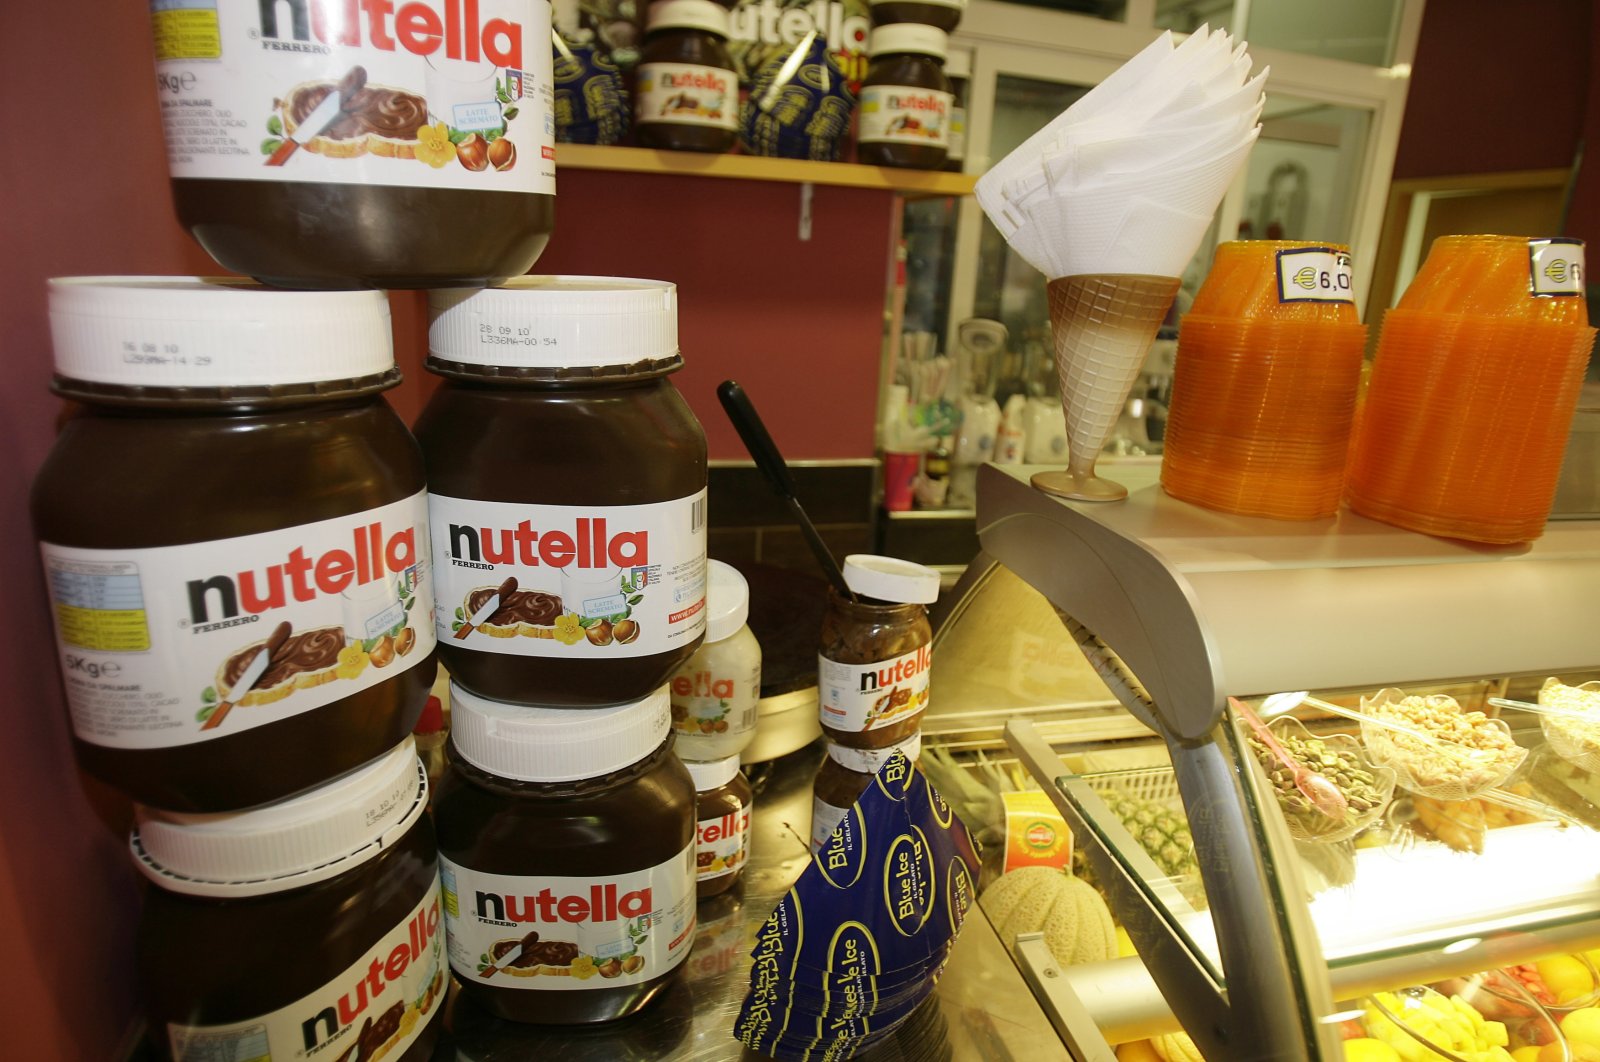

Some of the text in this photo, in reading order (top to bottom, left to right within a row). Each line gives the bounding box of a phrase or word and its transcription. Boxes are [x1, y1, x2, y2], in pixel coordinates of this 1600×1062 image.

[260, 0, 523, 70] nutella
[729, 0, 871, 51] utella
[261, 41, 332, 56] FERRERO
[661, 71, 727, 93] nutella
[1320, 271, 1352, 291] 6,0
[449, 517, 648, 568] nutella
[187, 522, 415, 623] nutella
[452, 559, 494, 571] FERRERO
[593, 600, 613, 608] LATTE
[193, 614, 260, 634] FERRERO
[672, 671, 734, 698] ella
[696, 812, 750, 846] tella
[827, 827, 848, 870] Blue
[896, 852, 915, 920] Blue Ice
[475, 884, 652, 923] nutella
[478, 918, 517, 928] FERRERO
[762, 911, 784, 952] Blue
[841, 939, 858, 965] Ice
[860, 950, 868, 976] ELATO
[302, 895, 440, 1052] nutella
